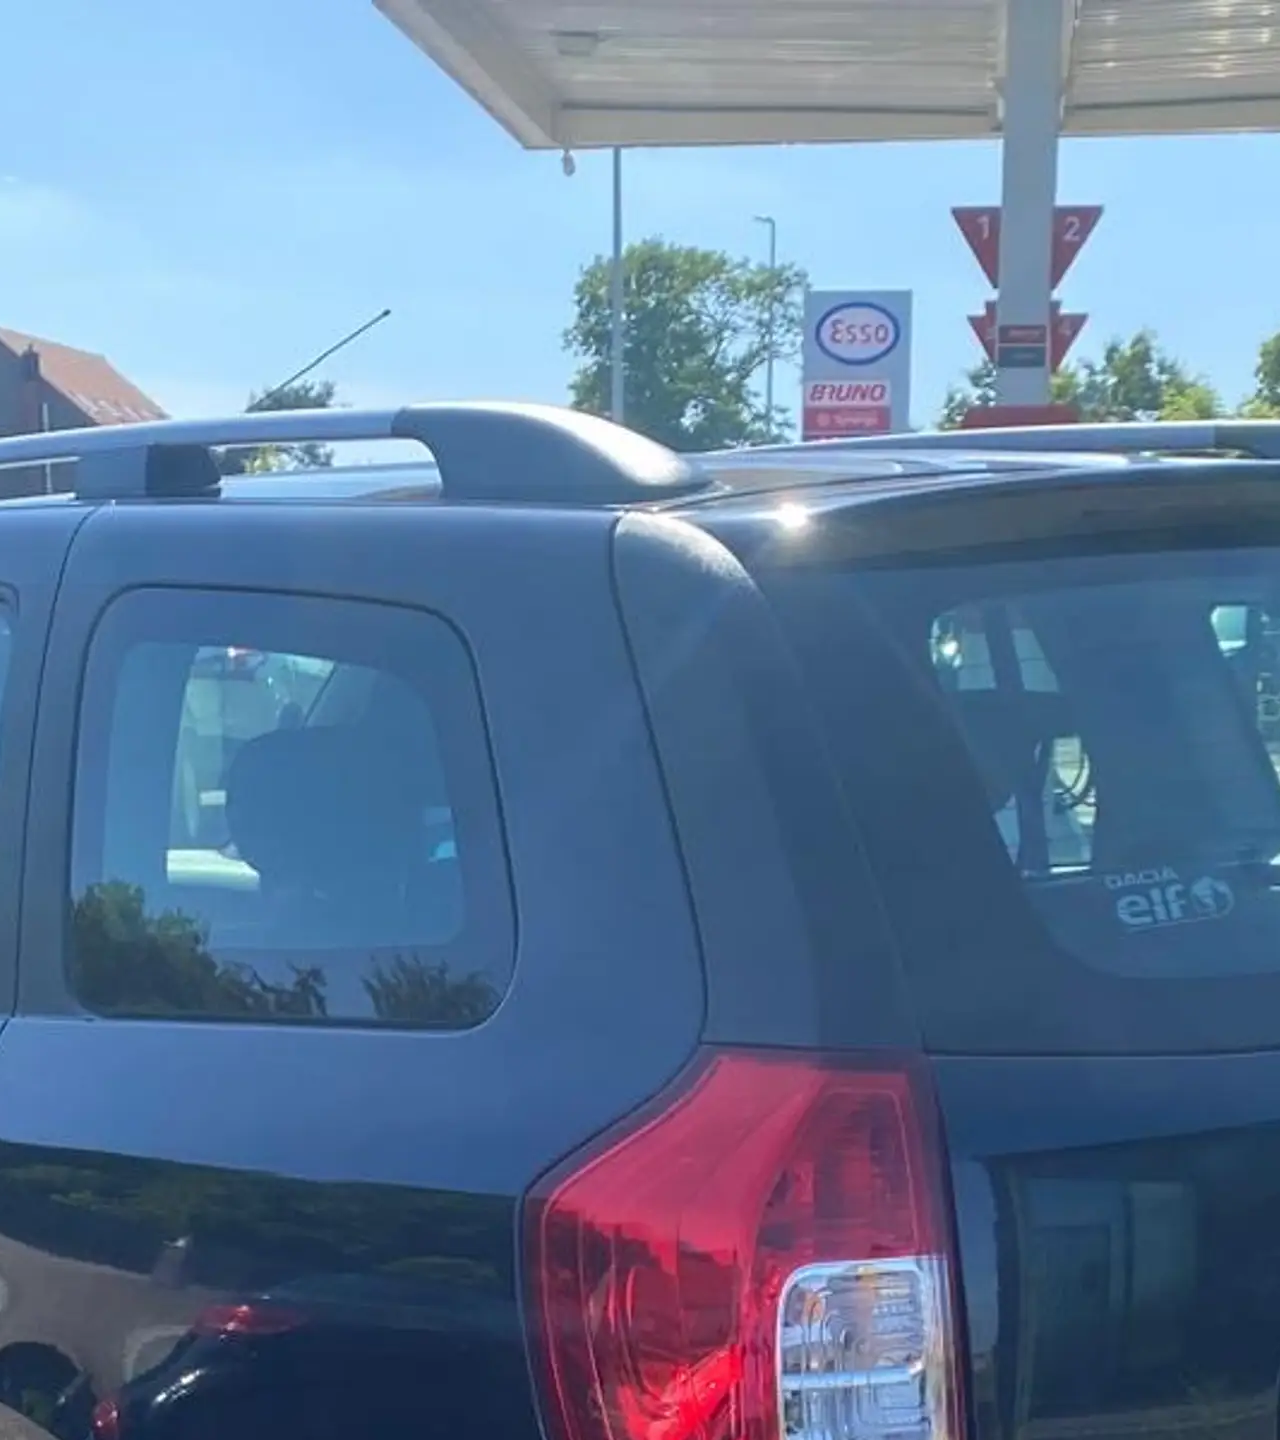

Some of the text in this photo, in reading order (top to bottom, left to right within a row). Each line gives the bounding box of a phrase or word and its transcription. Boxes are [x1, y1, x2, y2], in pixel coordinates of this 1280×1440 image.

[976, 214, 991, 240] 1
[1063, 216, 1081, 241] 2
[809, 383, 888, 402] BRUNO
[1116, 883, 1186, 926] elf
